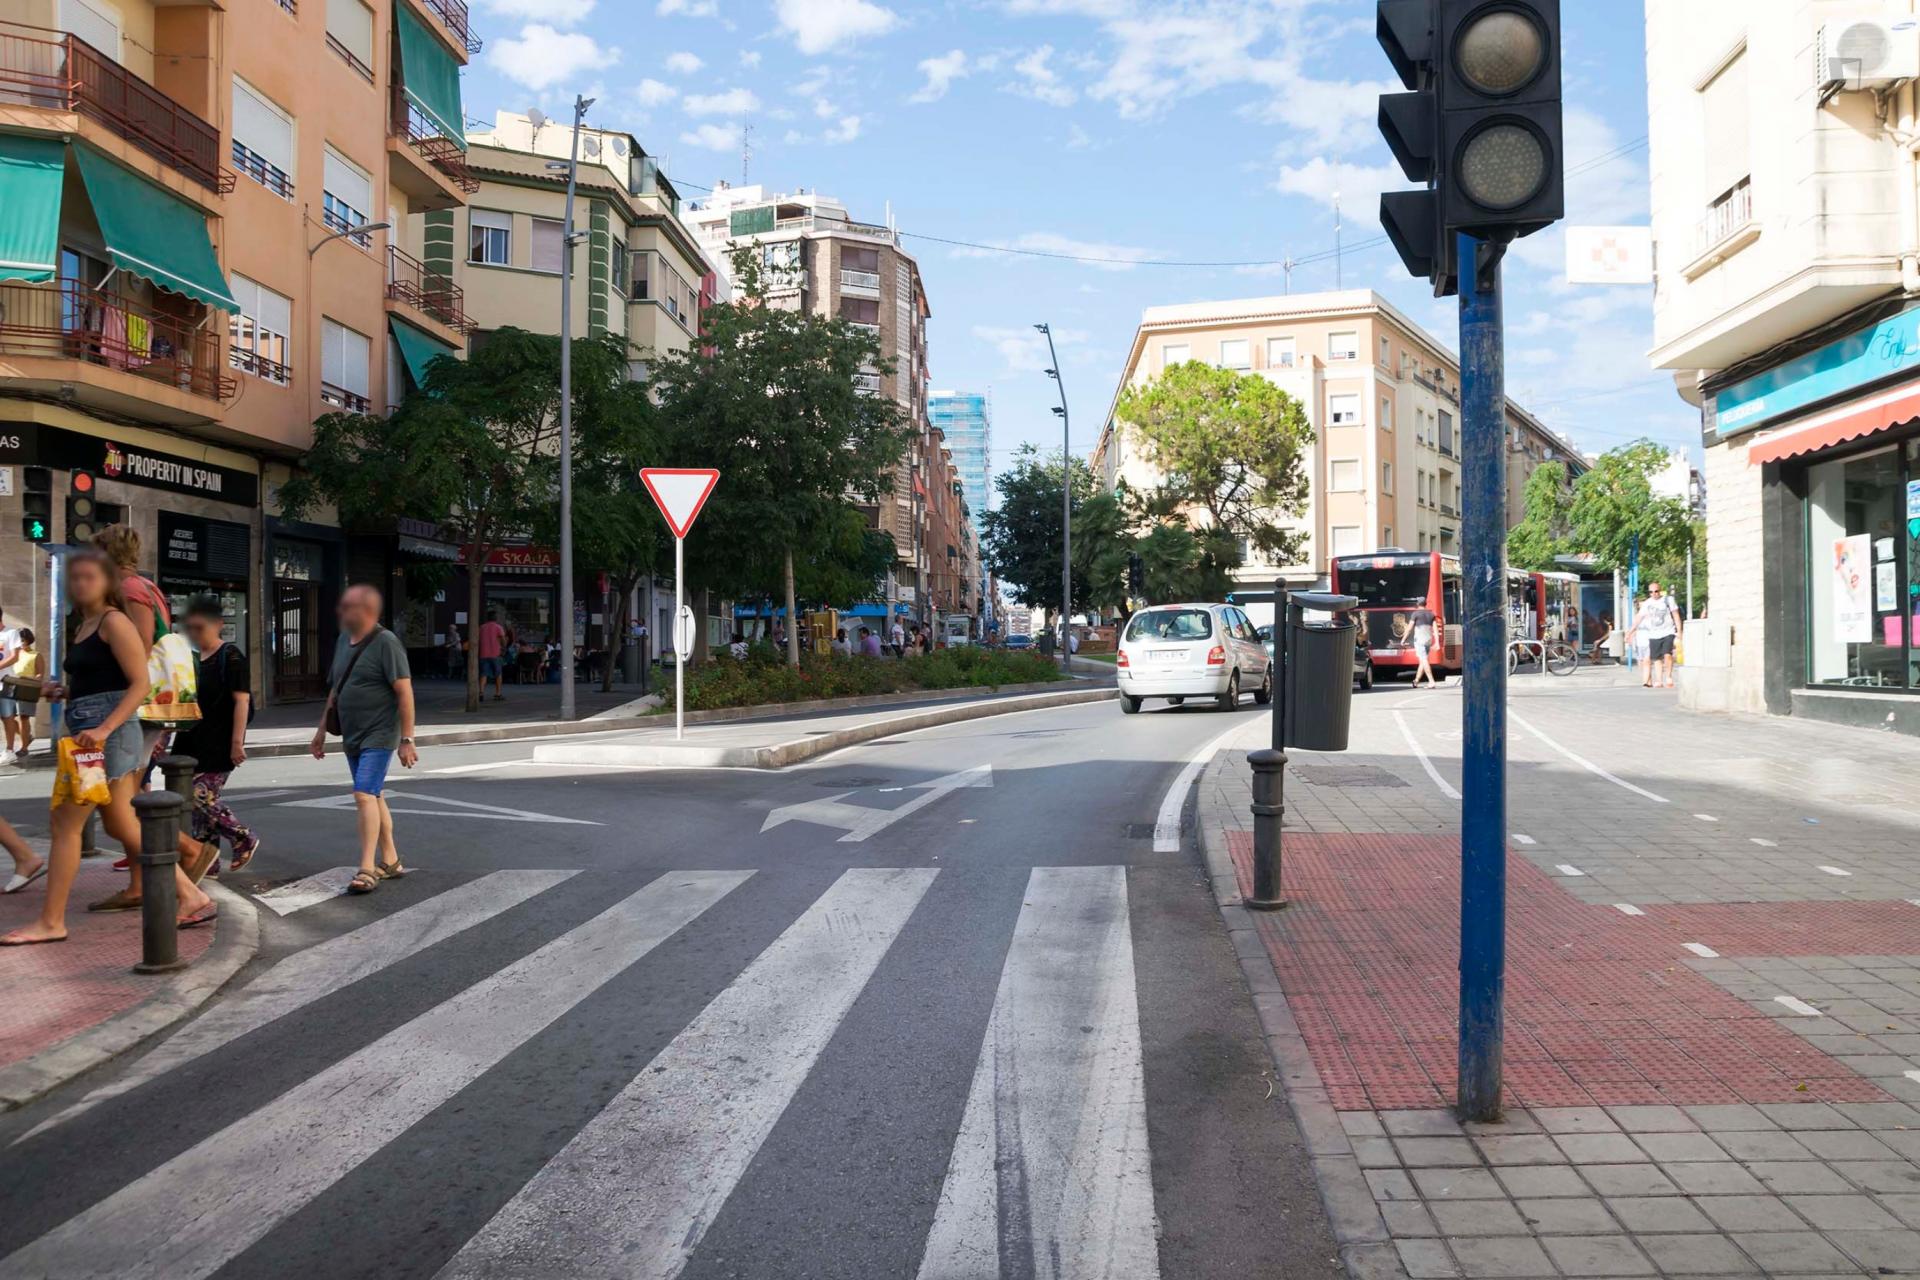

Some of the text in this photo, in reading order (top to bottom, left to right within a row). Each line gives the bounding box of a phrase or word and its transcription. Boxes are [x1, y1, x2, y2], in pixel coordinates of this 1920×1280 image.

[126, 453, 181, 484] PROPERTY
[182, 466, 193, 486] IN
[194, 469, 222, 492] SPAIN
